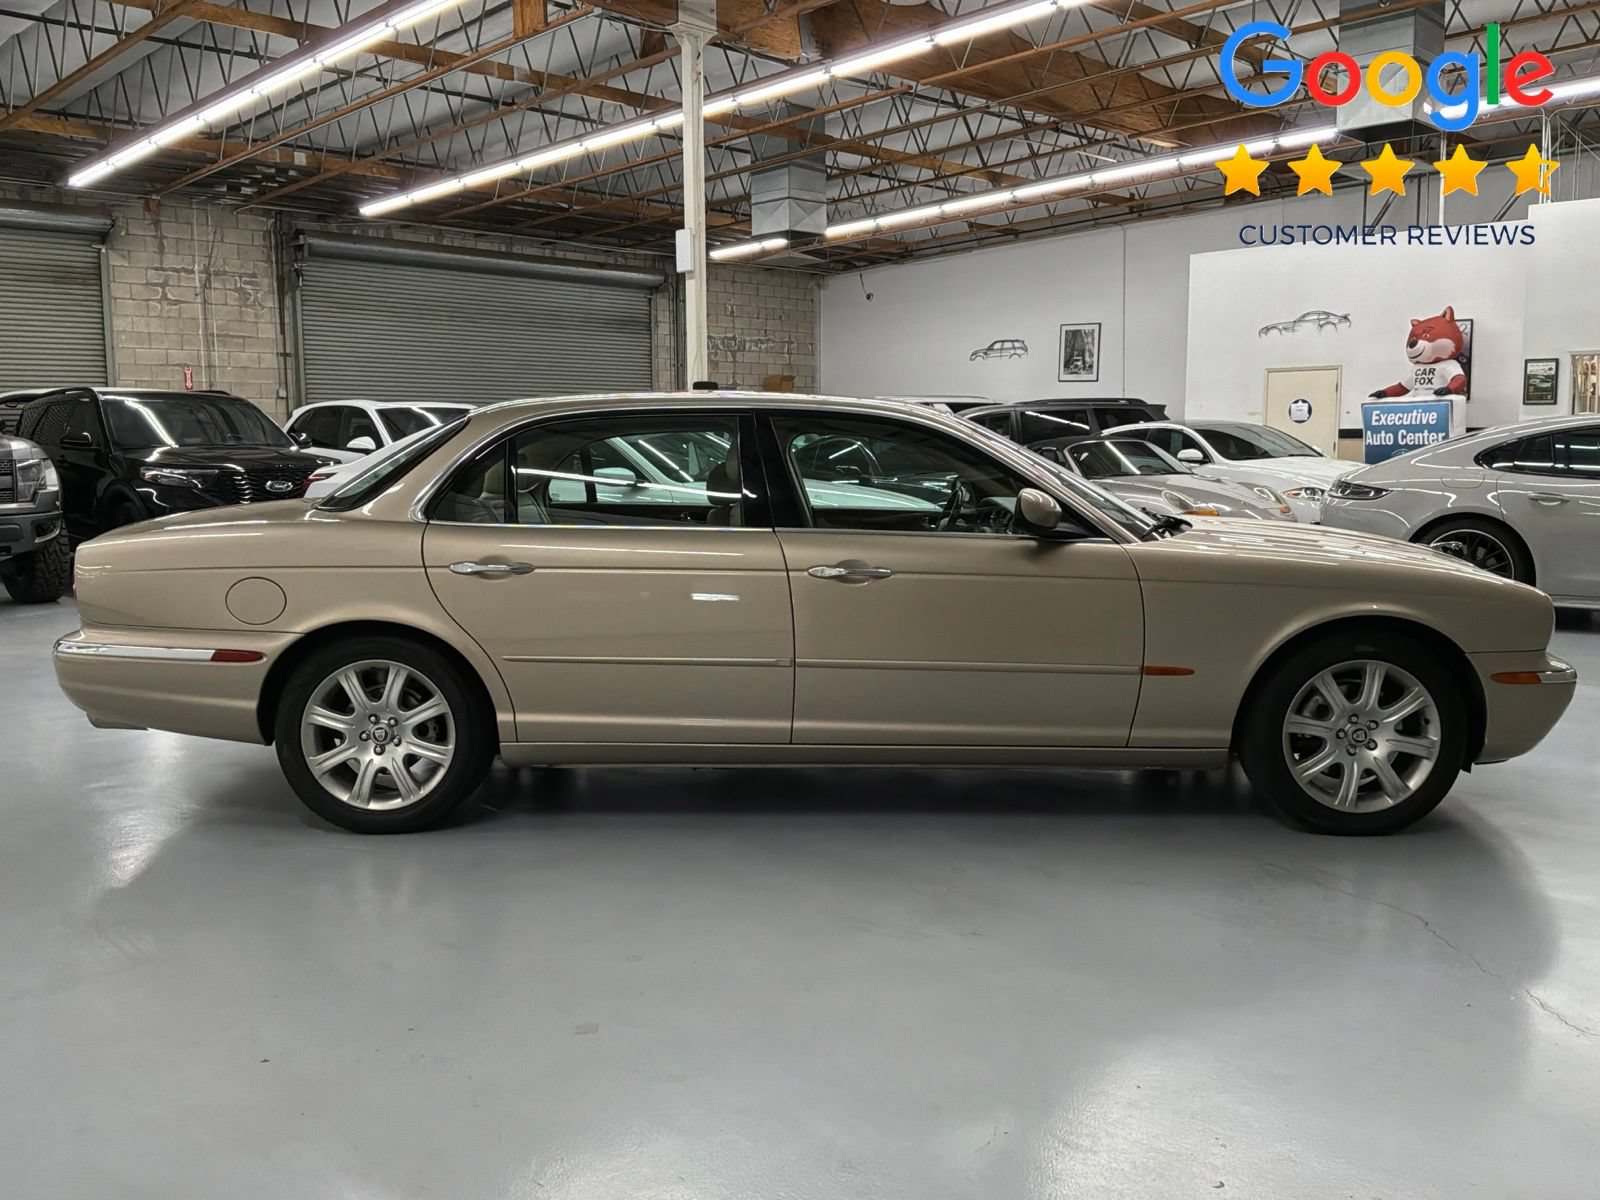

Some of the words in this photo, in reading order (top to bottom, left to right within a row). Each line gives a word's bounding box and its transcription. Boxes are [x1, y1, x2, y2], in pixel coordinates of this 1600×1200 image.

[1414, 367, 1437, 377] CAR
[1414, 376, 1435, 386] FOX
[1371, 409, 1438, 426] Executive
[1365, 430, 1395, 446] Auto
[1397, 429, 1446, 446] Center
